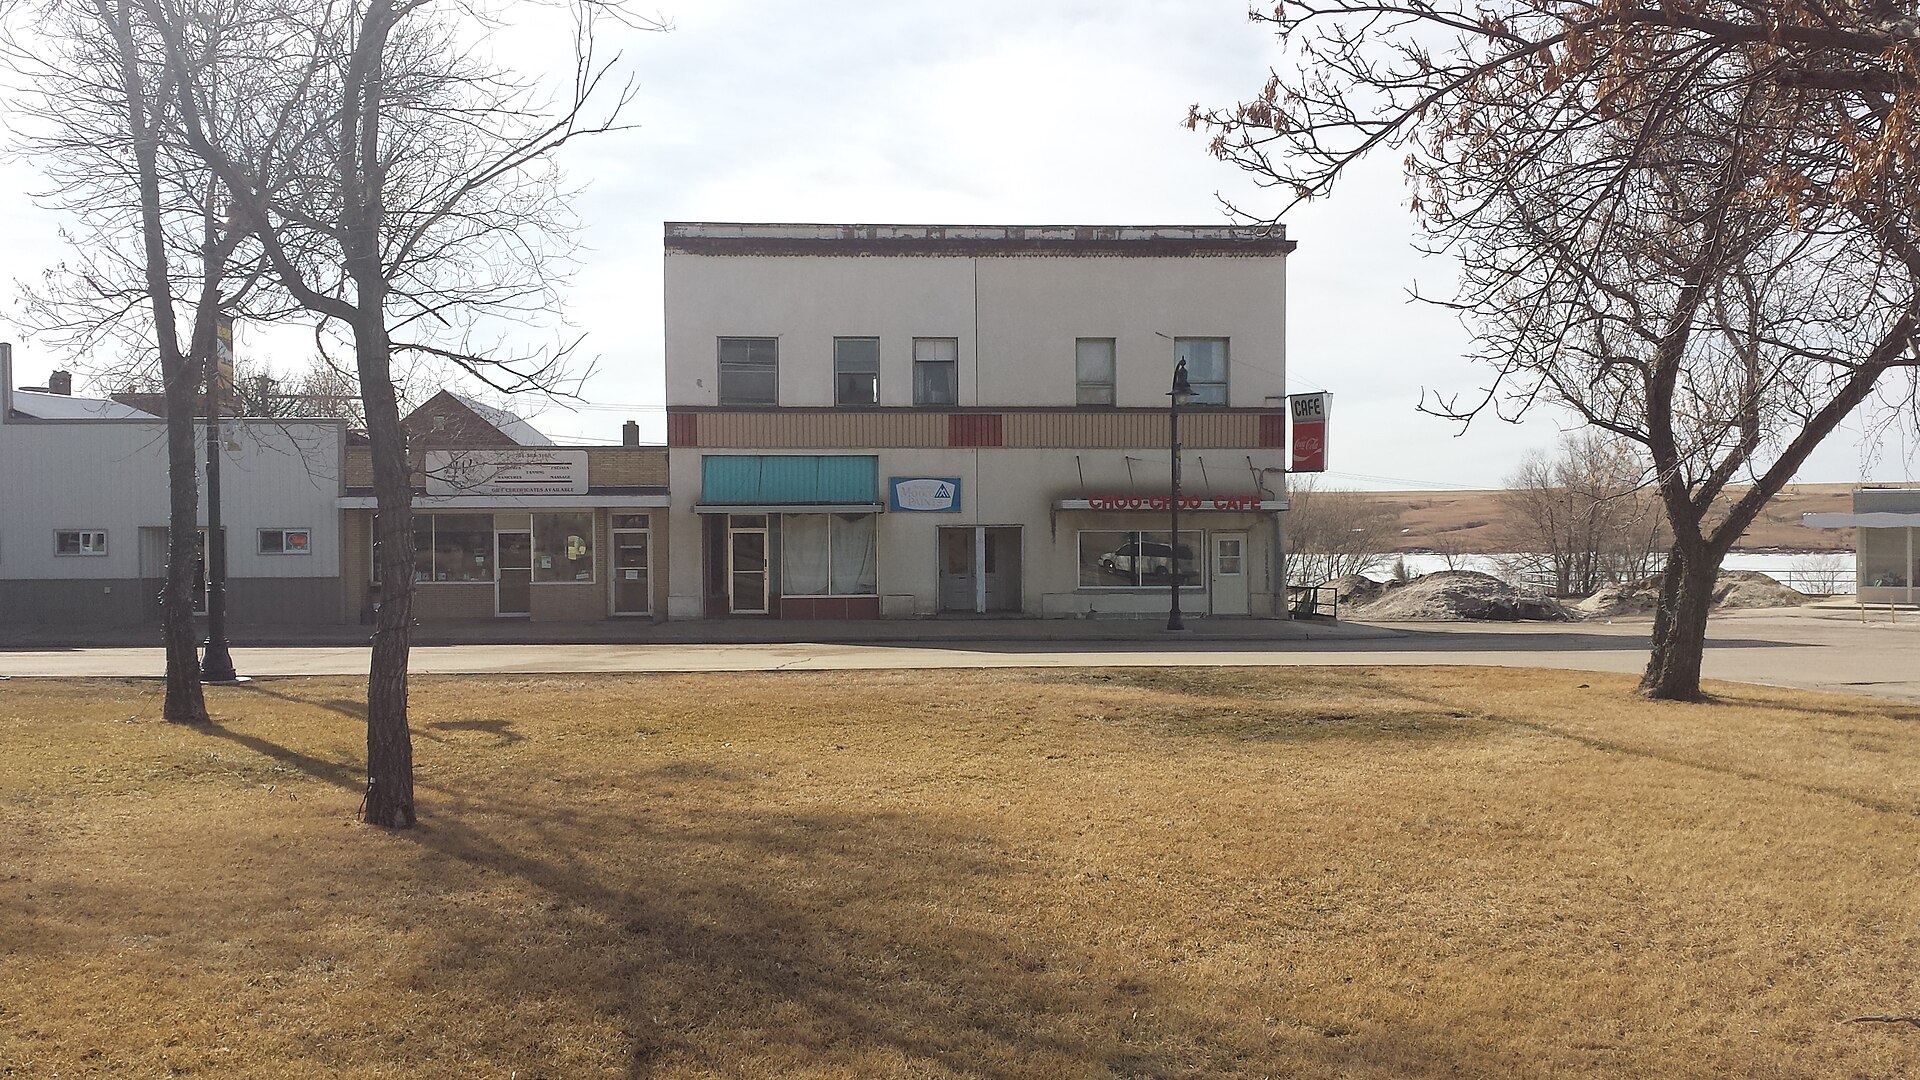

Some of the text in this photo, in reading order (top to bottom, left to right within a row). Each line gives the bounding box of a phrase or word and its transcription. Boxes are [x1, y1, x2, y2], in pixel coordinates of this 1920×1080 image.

[1295, 398, 1320, 416] CAFE
[1089, 495, 1262, 510] CHOO-CHOO CAFE
